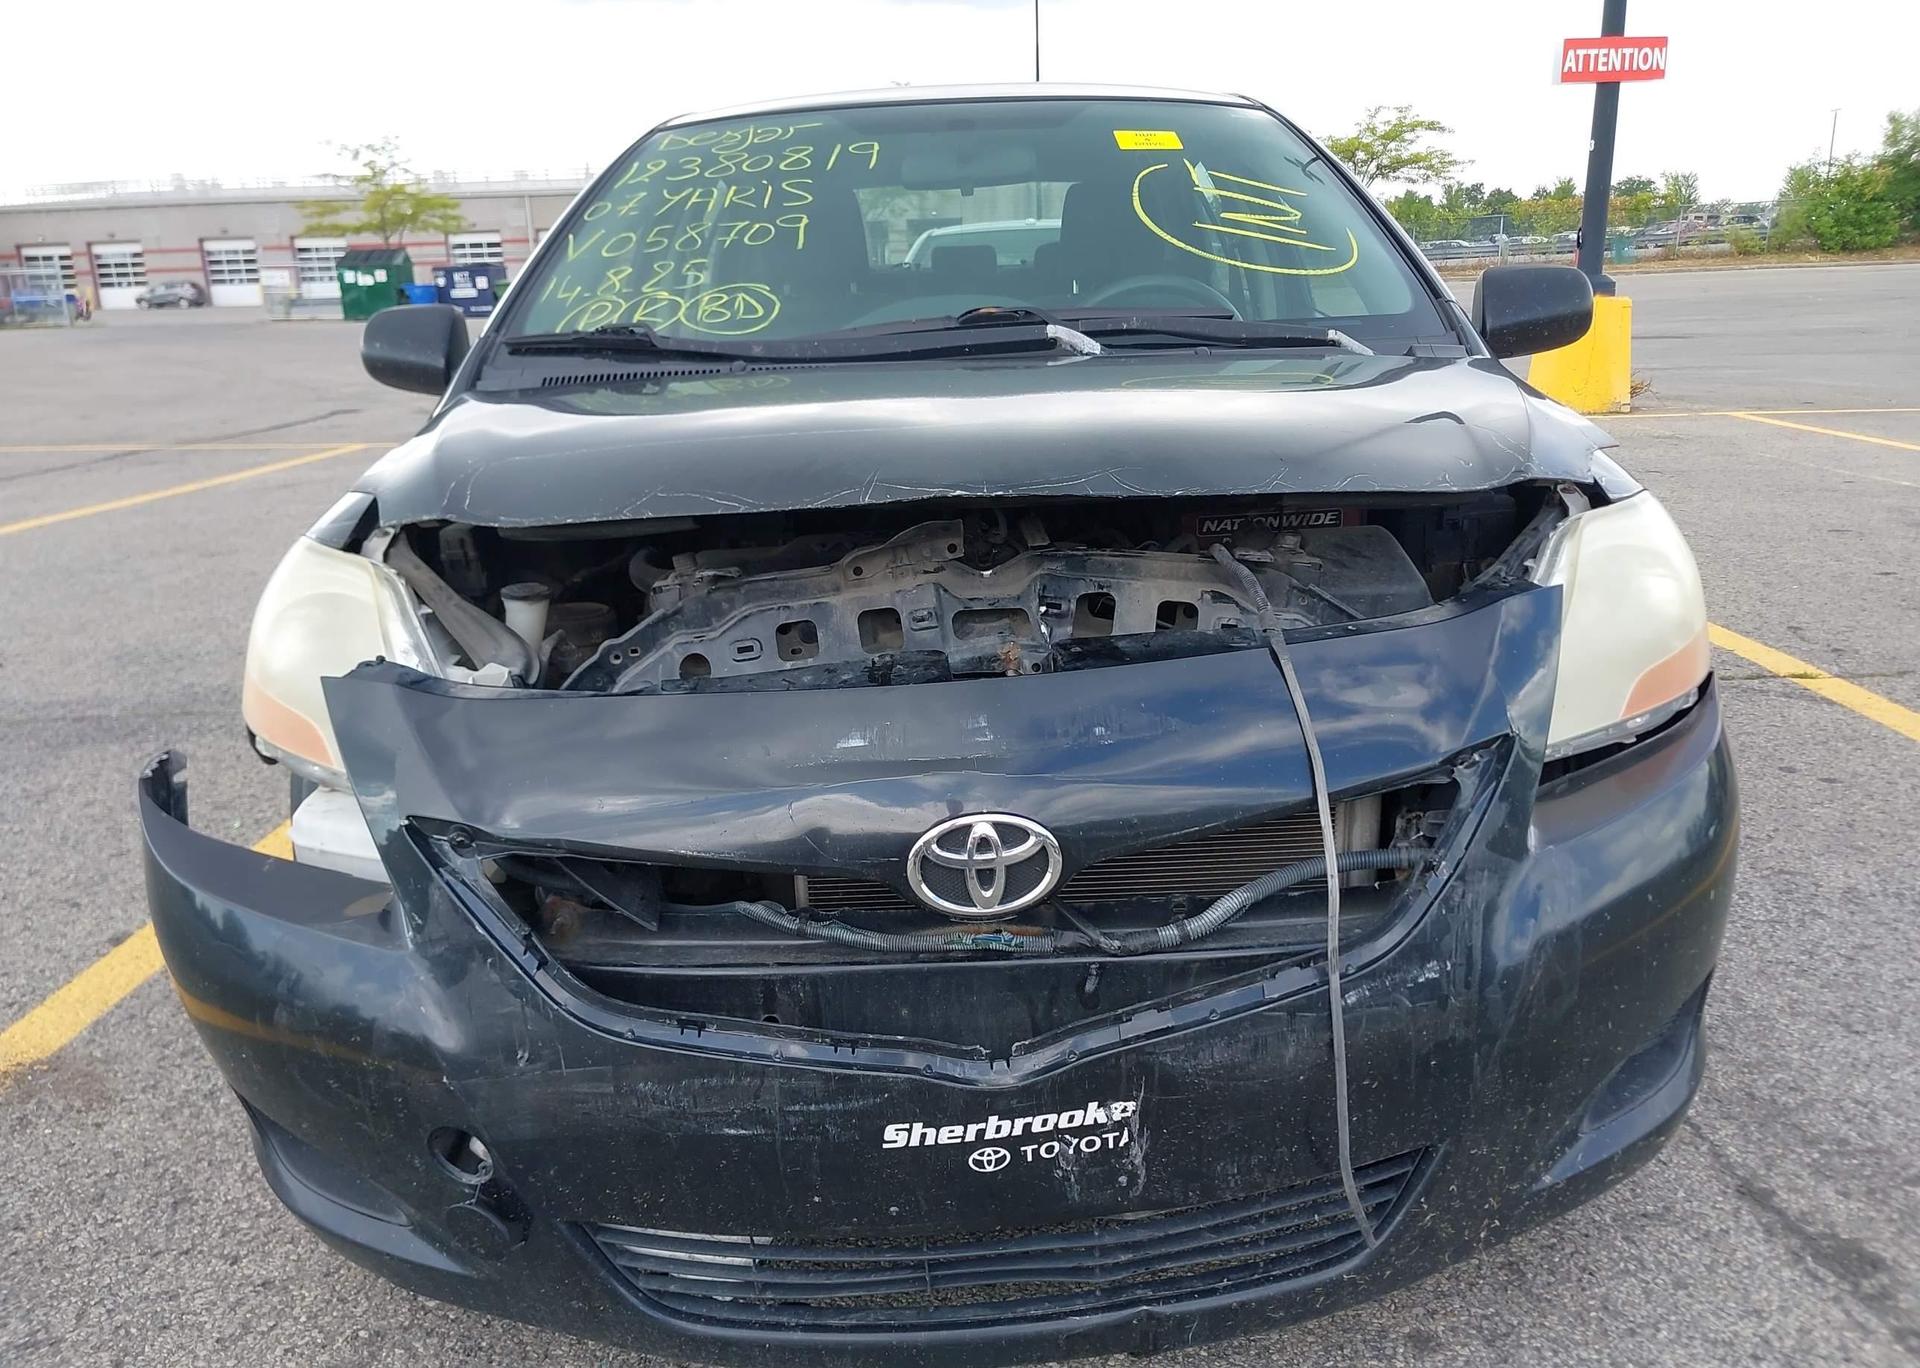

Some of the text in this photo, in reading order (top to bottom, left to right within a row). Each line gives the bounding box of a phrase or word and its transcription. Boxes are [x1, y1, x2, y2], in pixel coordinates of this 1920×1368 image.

[1562, 47, 1667, 73] ATTENTION
[614, 141, 881, 188] 12380819
[1202, 511, 1341, 533] NATONWIDE
[882, 1101, 1138, 1149] Sherbrooke
